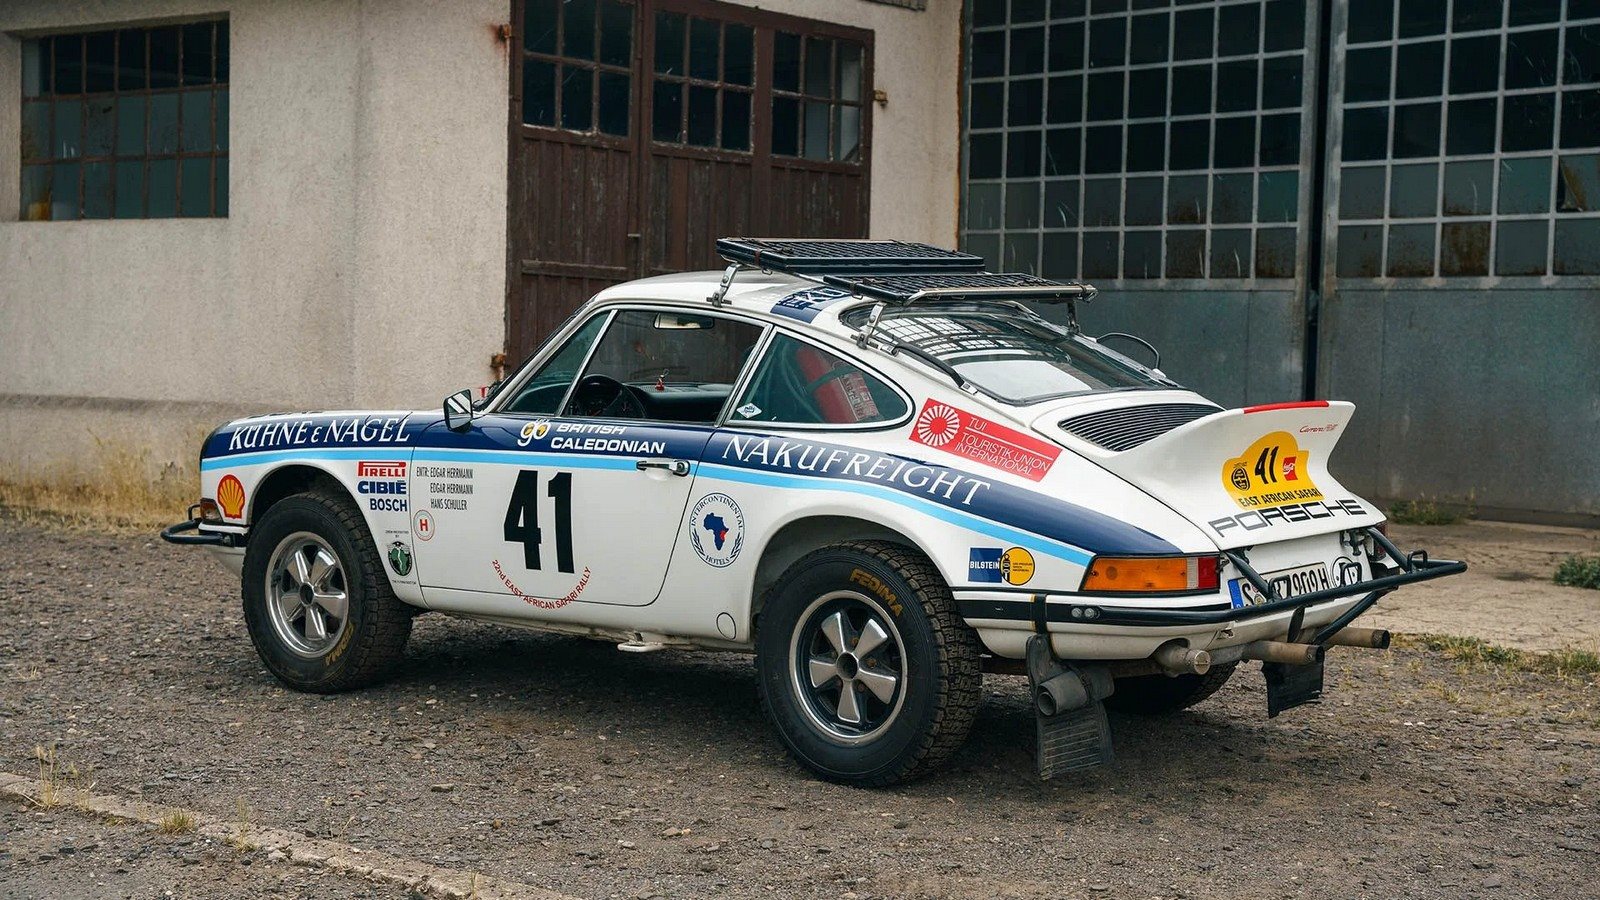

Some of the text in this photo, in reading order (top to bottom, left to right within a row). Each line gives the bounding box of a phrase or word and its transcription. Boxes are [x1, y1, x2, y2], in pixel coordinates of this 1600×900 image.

[324, 414, 413, 442] NAGEL
[556, 422, 628, 435] BRITISH
[968, 416, 988, 431] TUI
[550, 437, 666, 454] CALEDONIAN
[959, 432, 1051, 471] TOURISTIK UNION
[954, 442, 1033, 475] INTERNATIONAL
[1254, 446, 1280, 484] 41
[357, 461, 407, 477] PIRELLI
[430, 467, 446, 478] EDGAR
[446, 468, 474, 479] HERRMANN
[722, 435, 991, 506] NAKUFREIGHT
[430, 482, 474, 494] EDGAR HERRMANN
[1237, 487, 1322, 507] EAST AFRICAN SAFARI
[369, 498, 408, 512] BOSCH
[430, 498, 444, 509] HANS
[691, 495, 744, 530] INTERCONTINENTAL
[419, 518, 429, 531] H
[503, 469, 575, 574] 41
[1208, 499, 1368, 538] PORSCHE
[705, 555, 730, 565] HOTELS
[969, 561, 1000, 570] BILSTEIN
[491, 559, 592, 610] 22nd EAST AFRICAN SAFARI RALLY
[850, 567, 904, 617] FEDIMA
